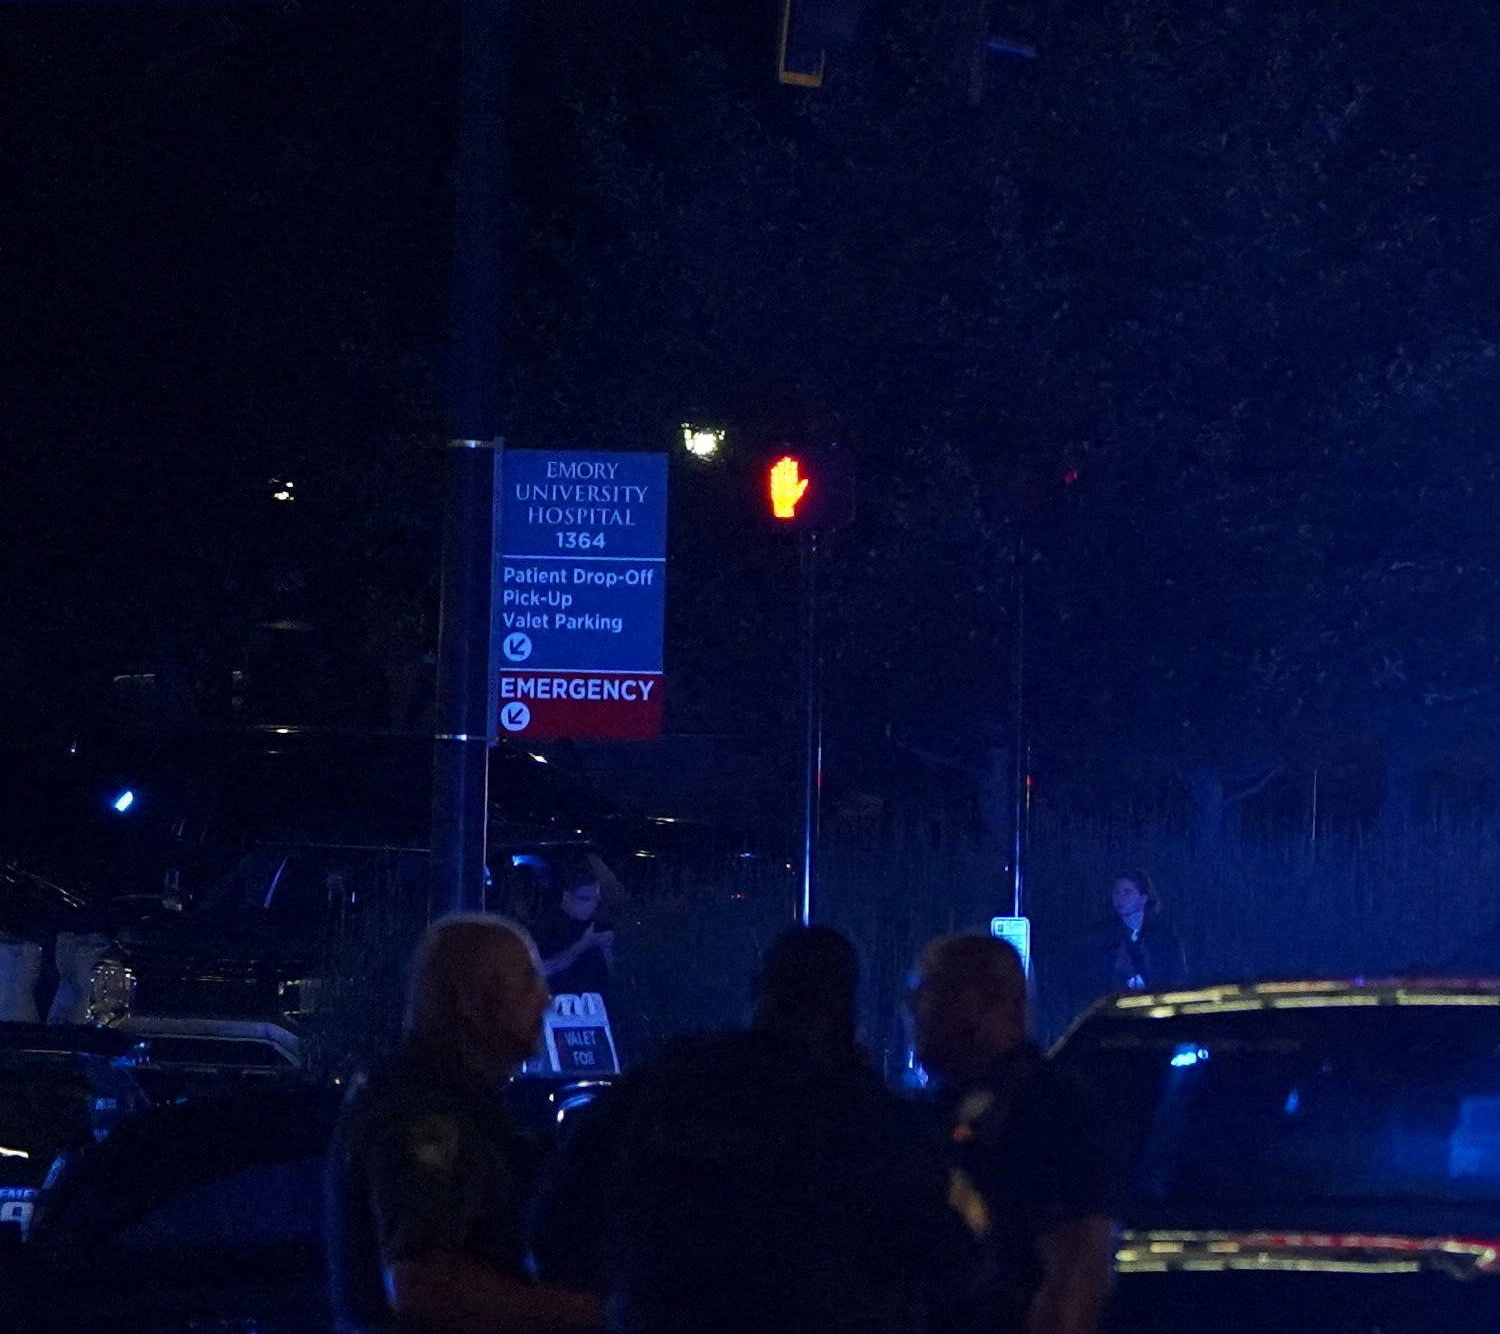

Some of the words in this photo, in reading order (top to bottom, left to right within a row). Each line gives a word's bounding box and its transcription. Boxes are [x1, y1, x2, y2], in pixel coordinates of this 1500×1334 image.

[547, 461, 620, 480] EMORY
[515, 483, 649, 503] UNIVERSITY
[528, 506, 637, 526] HOSPITAL
[556, 531, 606, 550] 1364
[503, 567, 567, 584] Patient
[573, 568, 654, 587] Drop-Off
[503, 590, 573, 608] Pick-Up
[503, 612, 549, 630] Valet
[555, 613, 623, 634] Parking
[500, 677, 655, 702] EMERGENCY
